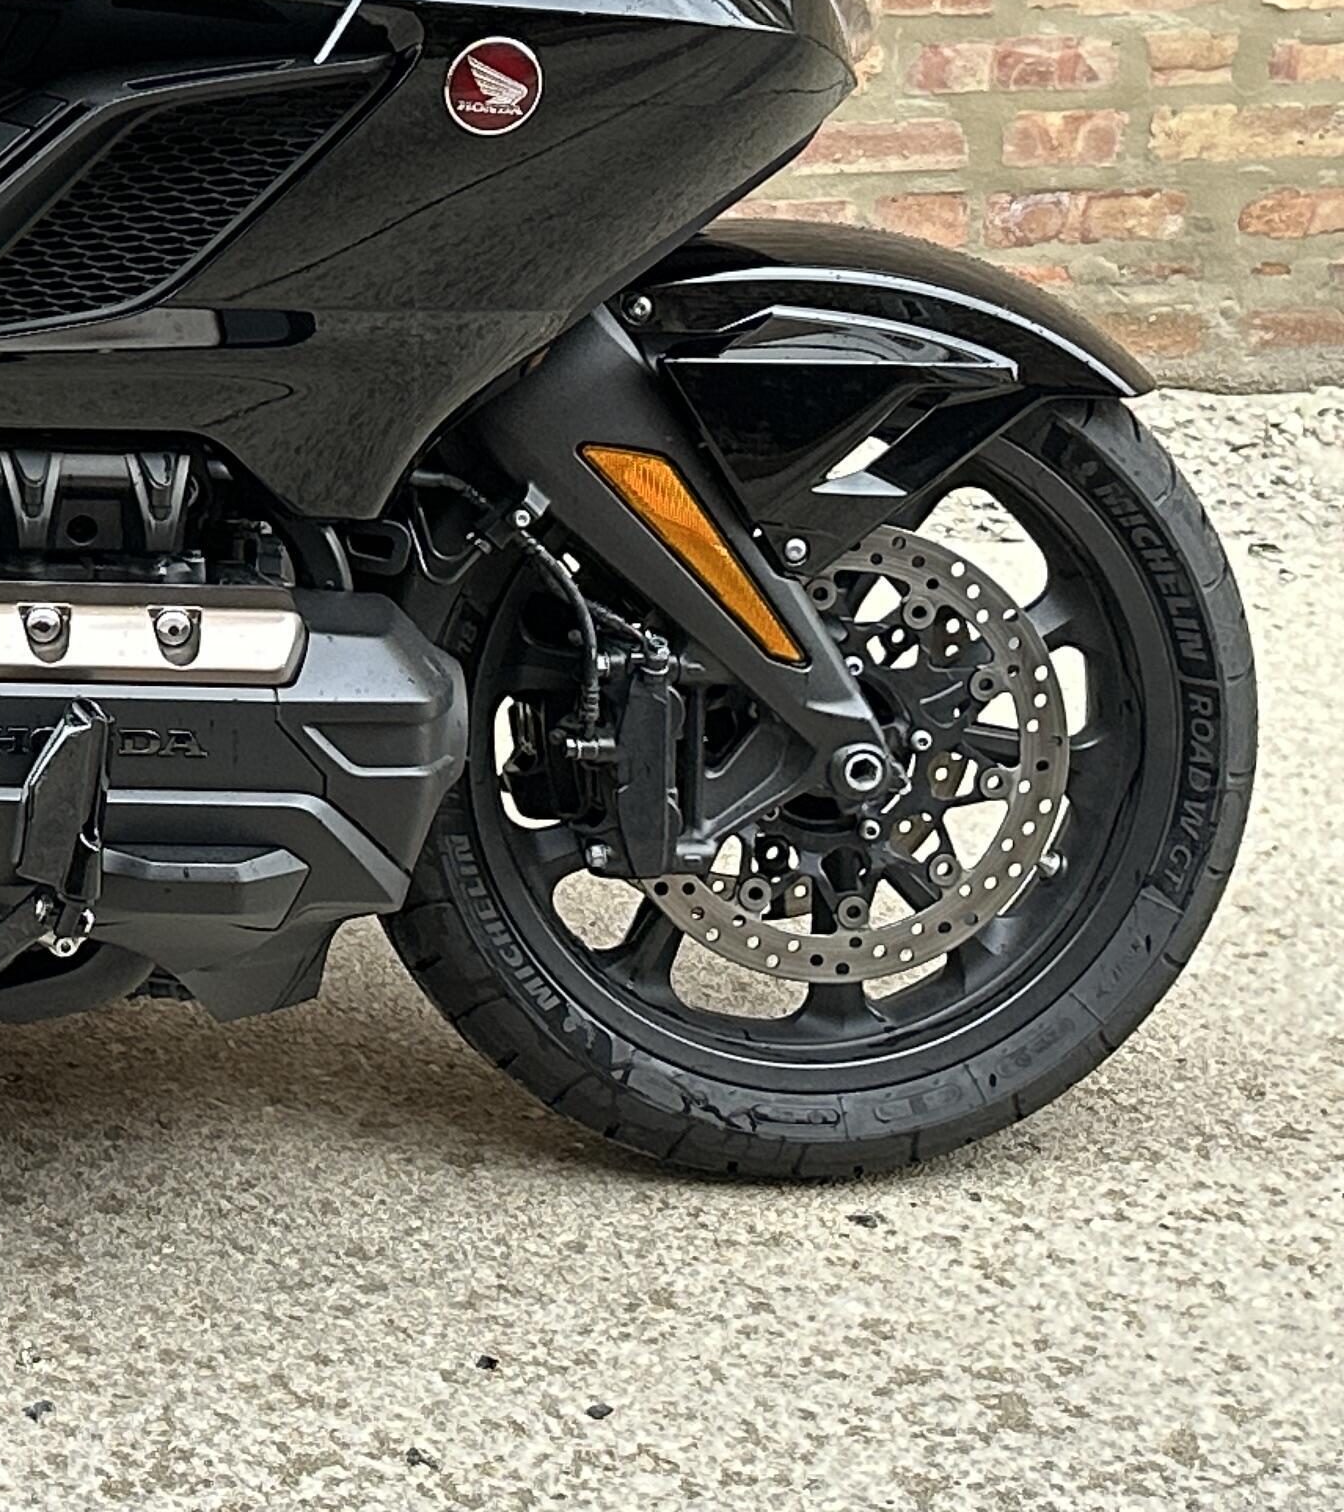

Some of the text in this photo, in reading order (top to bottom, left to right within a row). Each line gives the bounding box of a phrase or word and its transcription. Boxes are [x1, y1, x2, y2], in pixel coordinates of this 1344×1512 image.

[456, 100, 523, 116] HONDA
[1094, 481, 1208, 662] MICHELIN
[1186, 691, 1215, 793] ROAD
[1164, 844, 1193, 892] GT
[449, 834, 562, 1012] MICHELIN
